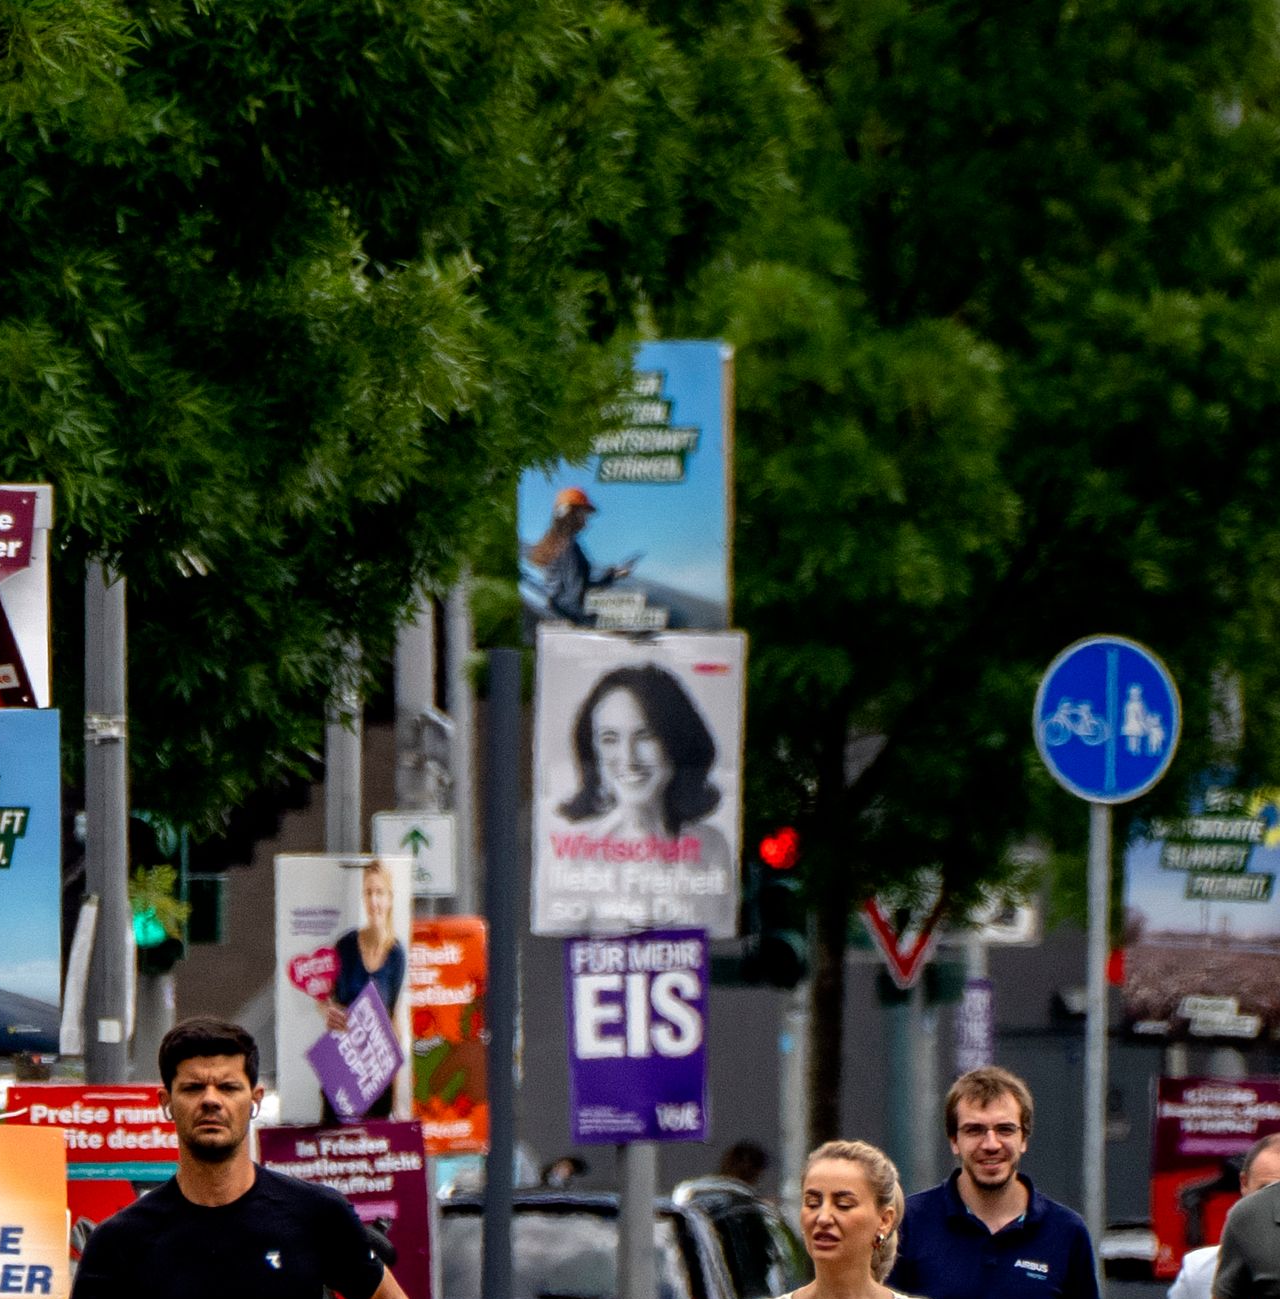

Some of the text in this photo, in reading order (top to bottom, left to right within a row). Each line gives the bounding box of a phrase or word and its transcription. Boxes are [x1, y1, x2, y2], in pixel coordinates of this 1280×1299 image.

[574, 971, 703, 1059] EIS
[29, 1101, 177, 1124] Preise runt
[64, 1127, 179, 1150] fite decke
[295, 1136, 389, 1158] In Frieden
[1014, 1259, 1049, 1273] AIRBUS
